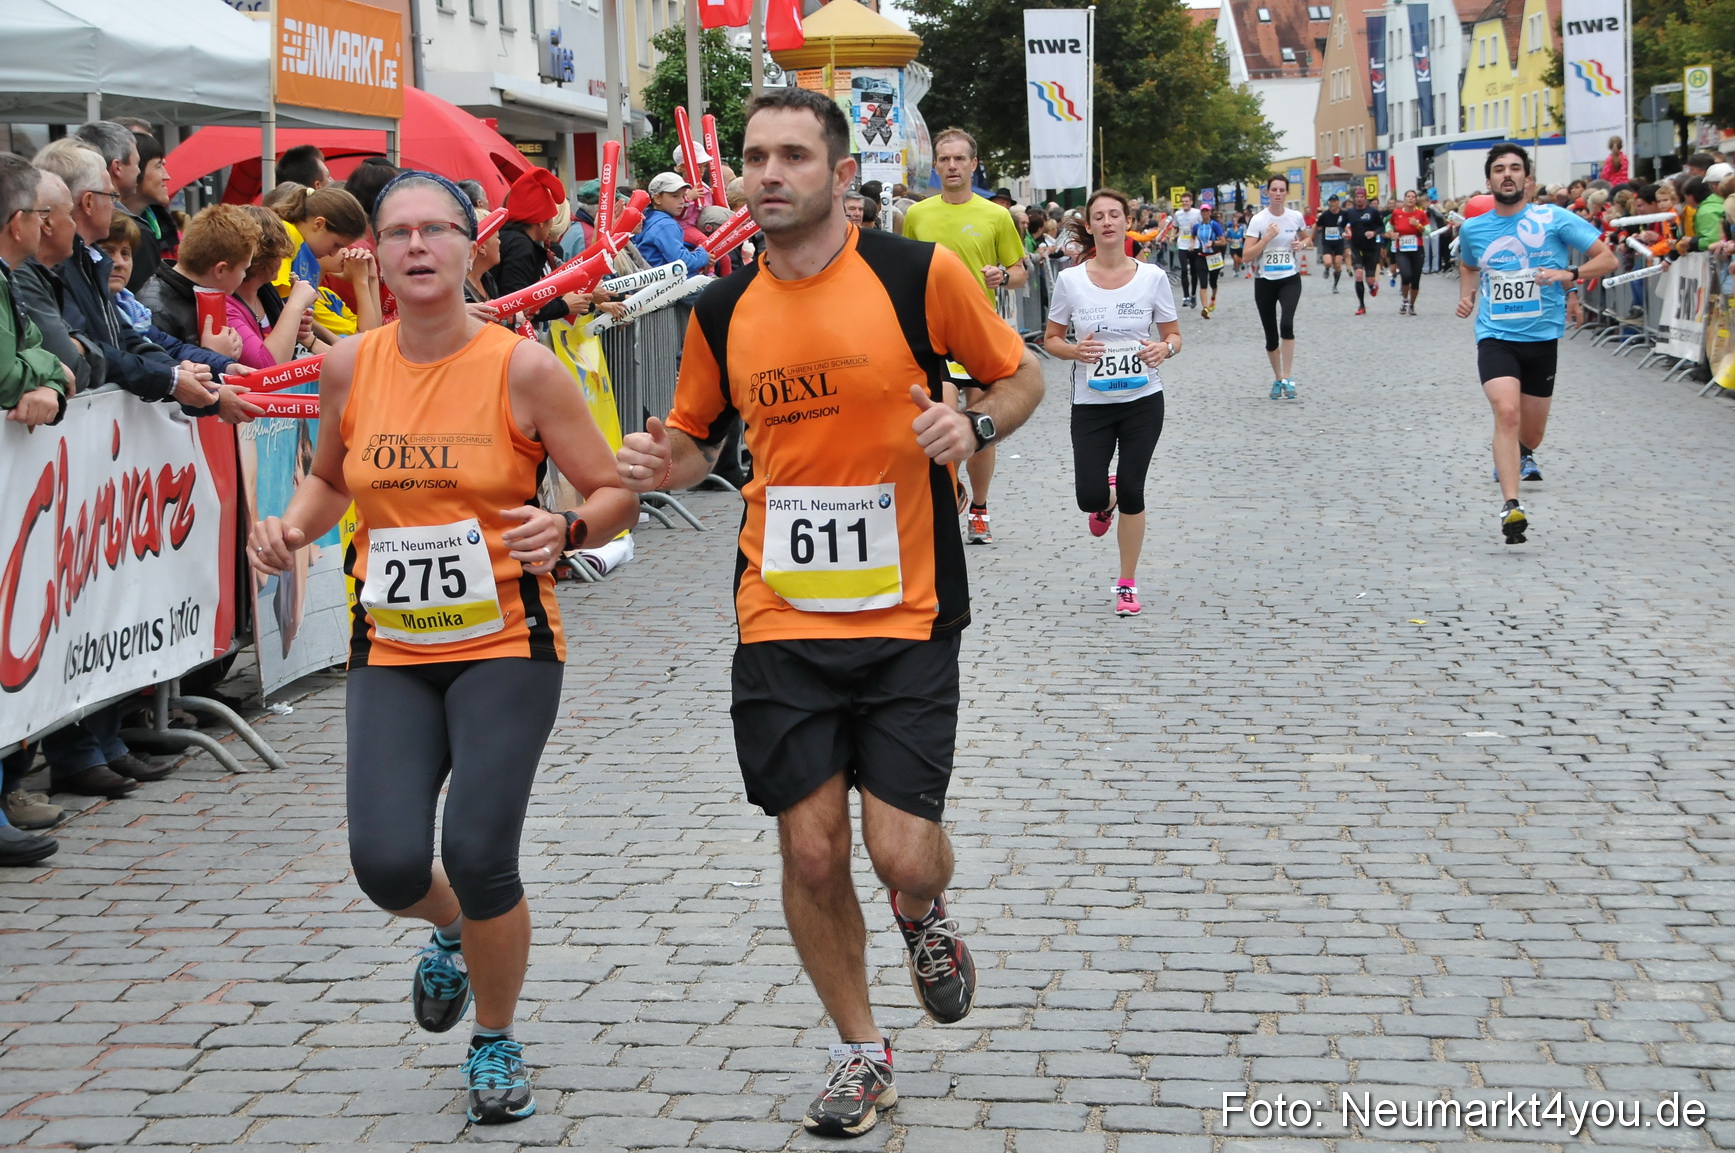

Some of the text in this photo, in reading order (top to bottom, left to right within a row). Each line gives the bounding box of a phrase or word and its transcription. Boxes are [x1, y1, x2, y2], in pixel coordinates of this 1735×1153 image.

[1368, 183, 1376, 194] D
[598, 192, 609, 234] Audi BKK
[705, 220, 734, 246] Audi BKK
[1266, 254, 1290, 264] 2878
[638, 268, 666, 287] BMW
[1493, 280, 1535, 301] 2687
[502, 297, 525, 312] BKK
[1079, 306, 1108, 314] PEUGEOT
[1504, 304, 1524, 312] Peter
[1108, 346, 1136, 354] Neumarkt
[786, 366, 812, 376] UHREN
[814, 362, 829, 371] UND
[830, 357, 868, 368] SCHMUCK
[1094, 354, 1142, 377] 2548
[262, 362, 321, 387] Audi BKK
[758, 372, 838, 408] OEXL
[1108, 381, 1128, 390] Julia
[266, 404, 300, 414] Audi
[800, 405, 840, 420] VISION
[410, 436, 436, 444] UHREN
[456, 436, 493, 444] SCHMUCK
[373, 446, 459, 470] OEXL
[414, 479, 458, 490] VISION
[768, 498, 874, 512] PARTL Neumarkt
[370, 536, 463, 553] PARTL Neumarkt
[790, 518, 868, 564] 611
[385, 554, 468, 604] 275
[401, 612, 464, 630] Monika
